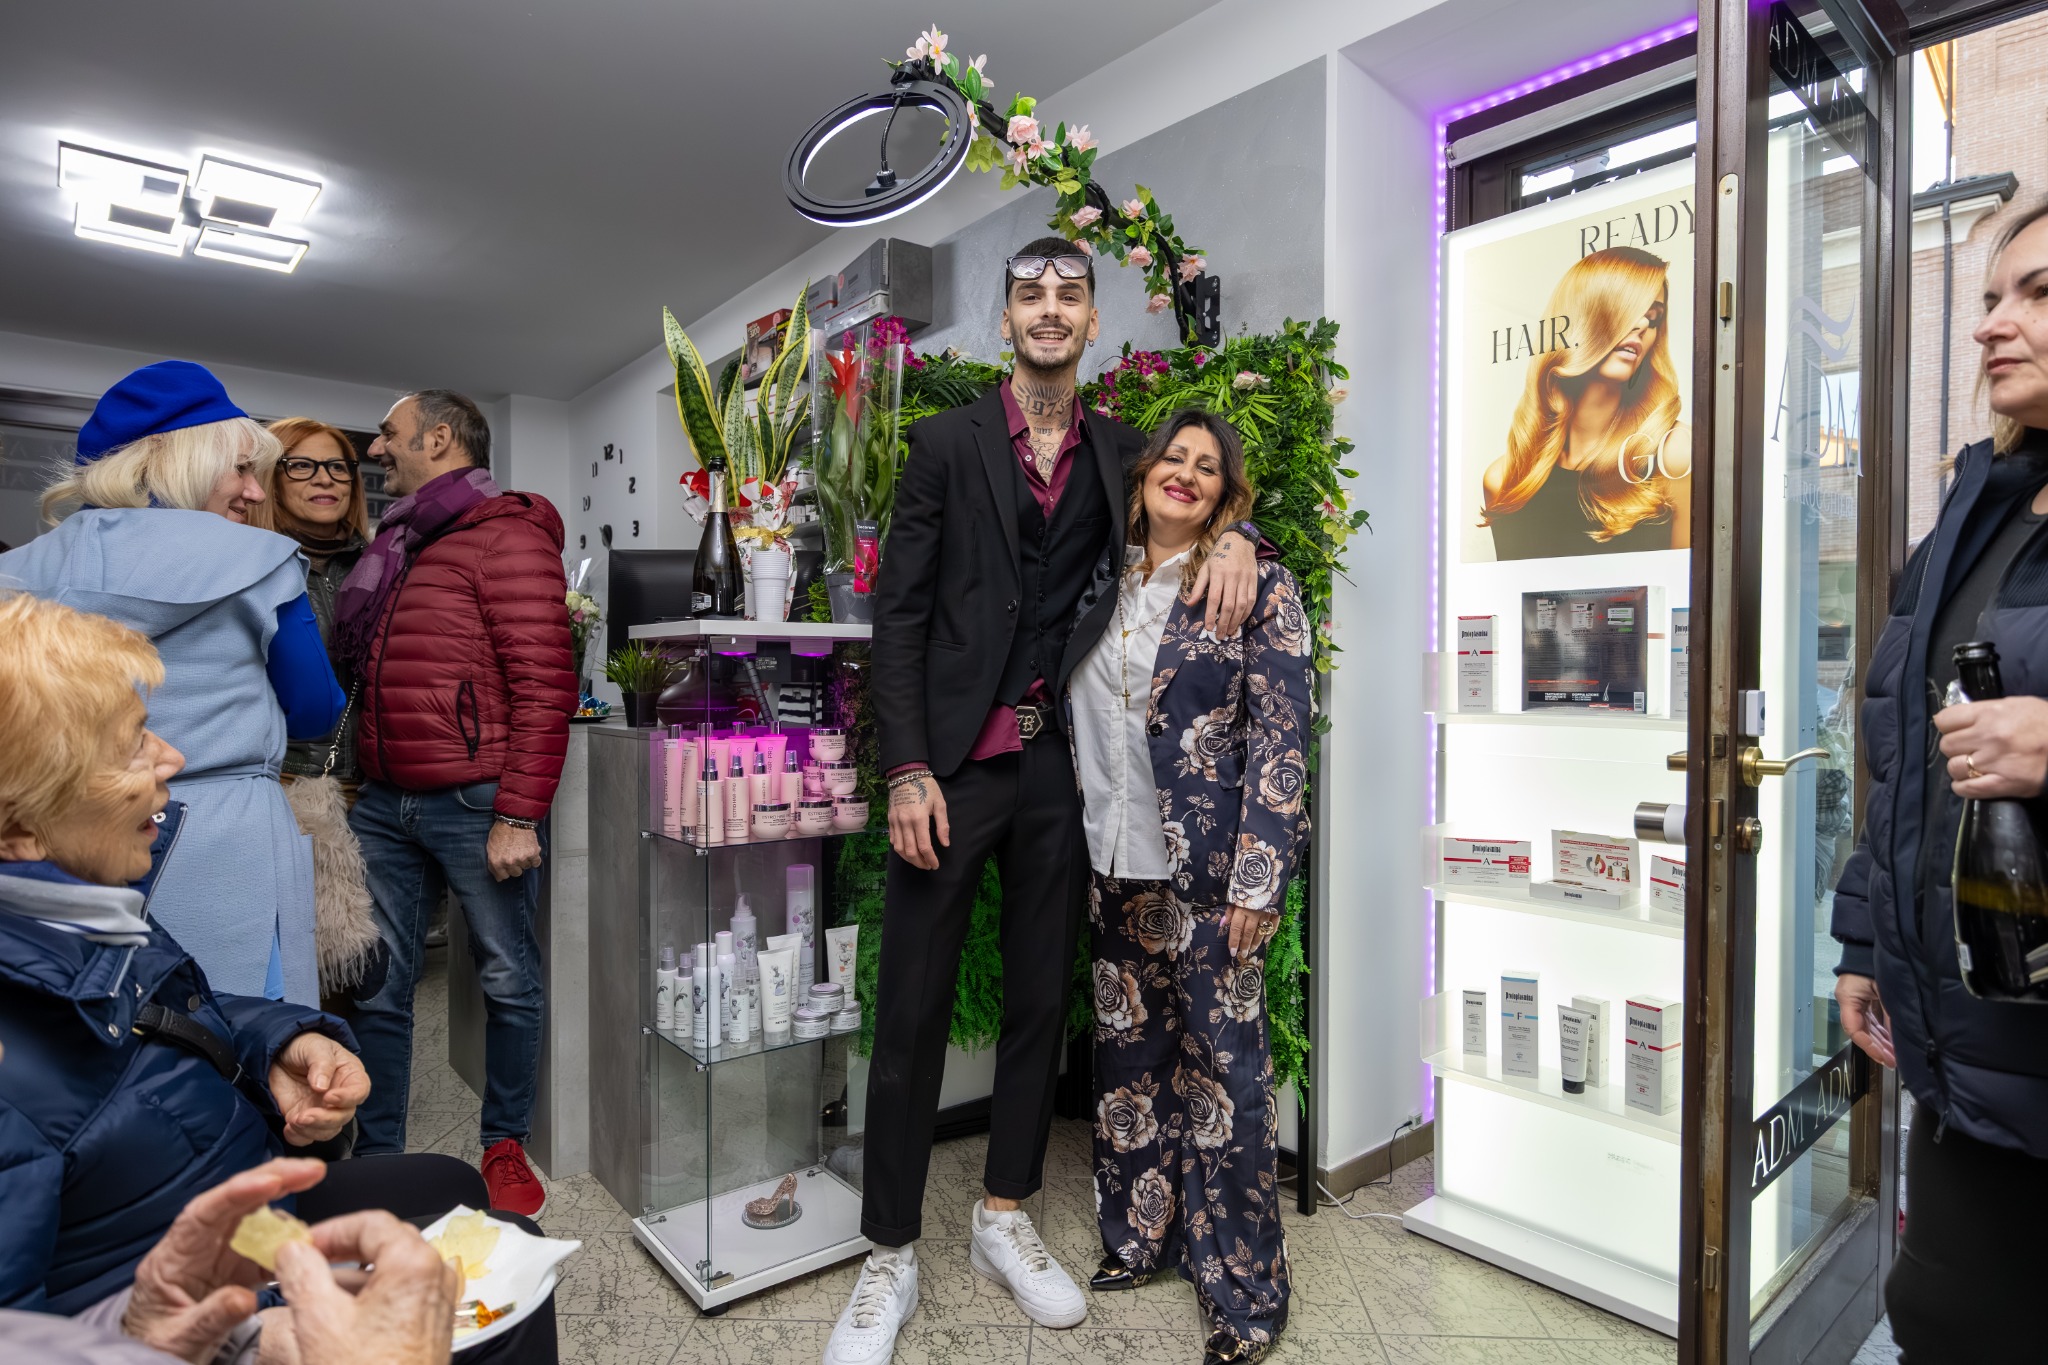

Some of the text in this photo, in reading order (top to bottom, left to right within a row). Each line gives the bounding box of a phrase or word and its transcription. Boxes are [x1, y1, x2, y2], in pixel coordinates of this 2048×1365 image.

[1492, 315, 1580, 364] HAIR.
[1022, 394, 1066, 417] 1973
[1770, 346, 1863, 477] ADM
[604, 443, 614, 461] 12
[619, 448, 623, 464] 1
[592, 461, 598, 478] 11
[628, 476, 636, 494] 2
[632, 520, 639, 537] 3
[580, 534, 586, 550] 9
[1471, 649, 1478, 657] A
[1517, 1012, 1522, 1020] F
[1639, 1041, 1647, 1050] A
[1751, 1096, 1805, 1187] ADM
